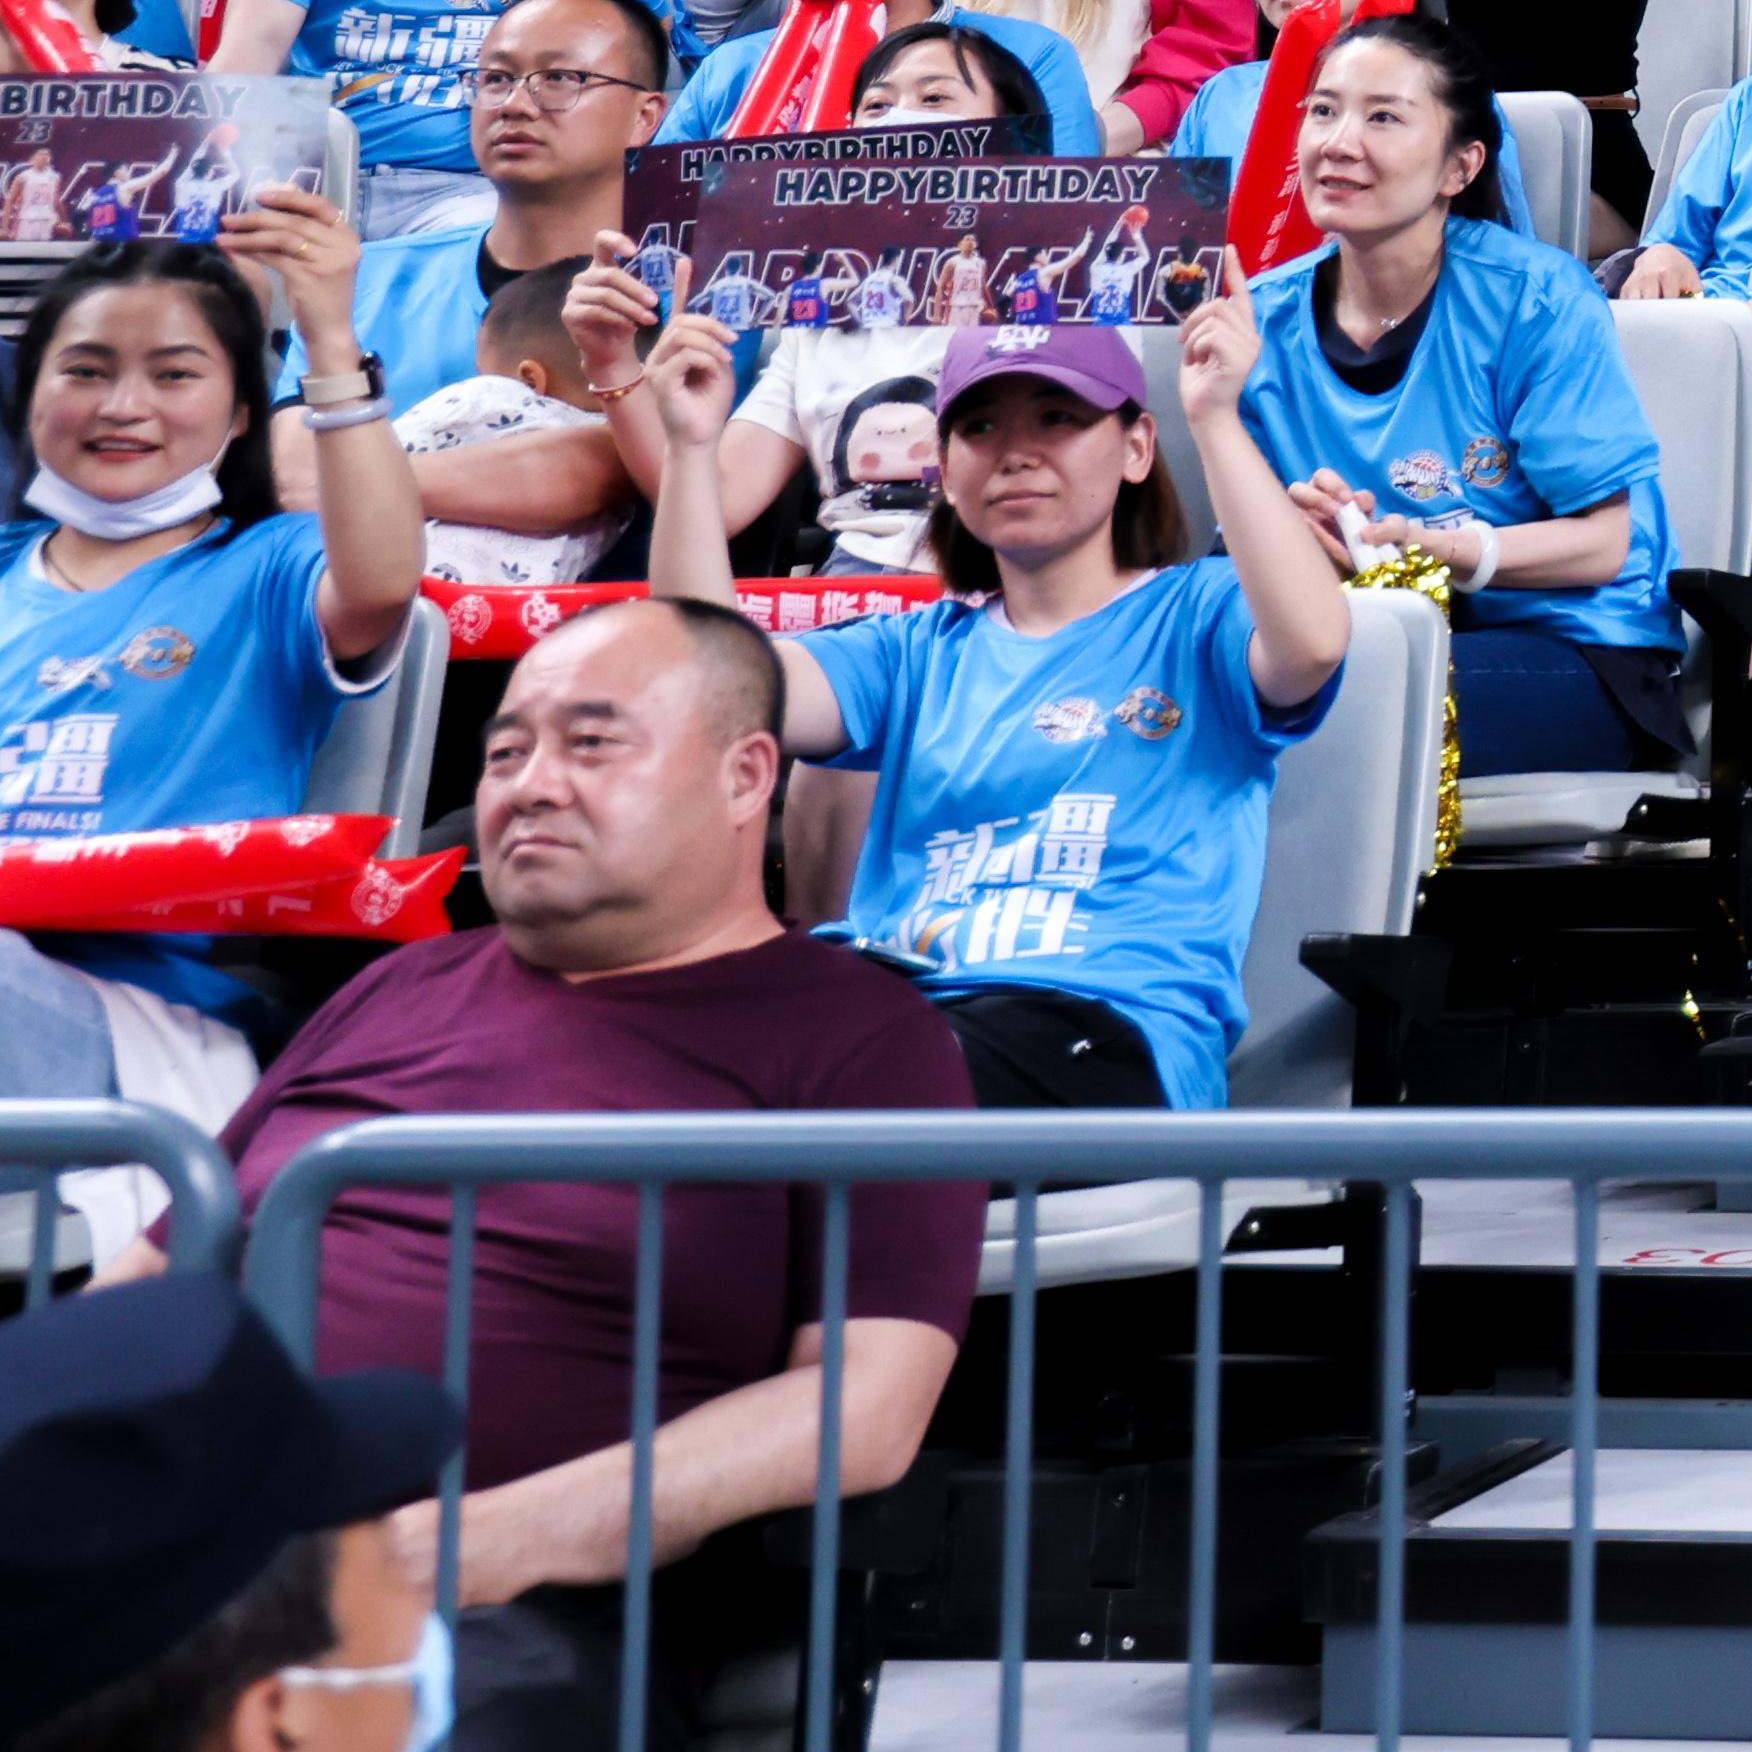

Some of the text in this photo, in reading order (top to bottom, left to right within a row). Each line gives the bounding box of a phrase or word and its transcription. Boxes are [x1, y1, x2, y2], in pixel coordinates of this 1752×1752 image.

[336, 6, 497, 72] 新疆
[15, 120, 52, 144] 23
[774, 164, 1158, 207] HAPPYBIRTHDAY
[943, 205, 978, 229] 23
[15, 811, 101, 831] FINALS!
[912, 793, 1116, 912] 新疆
